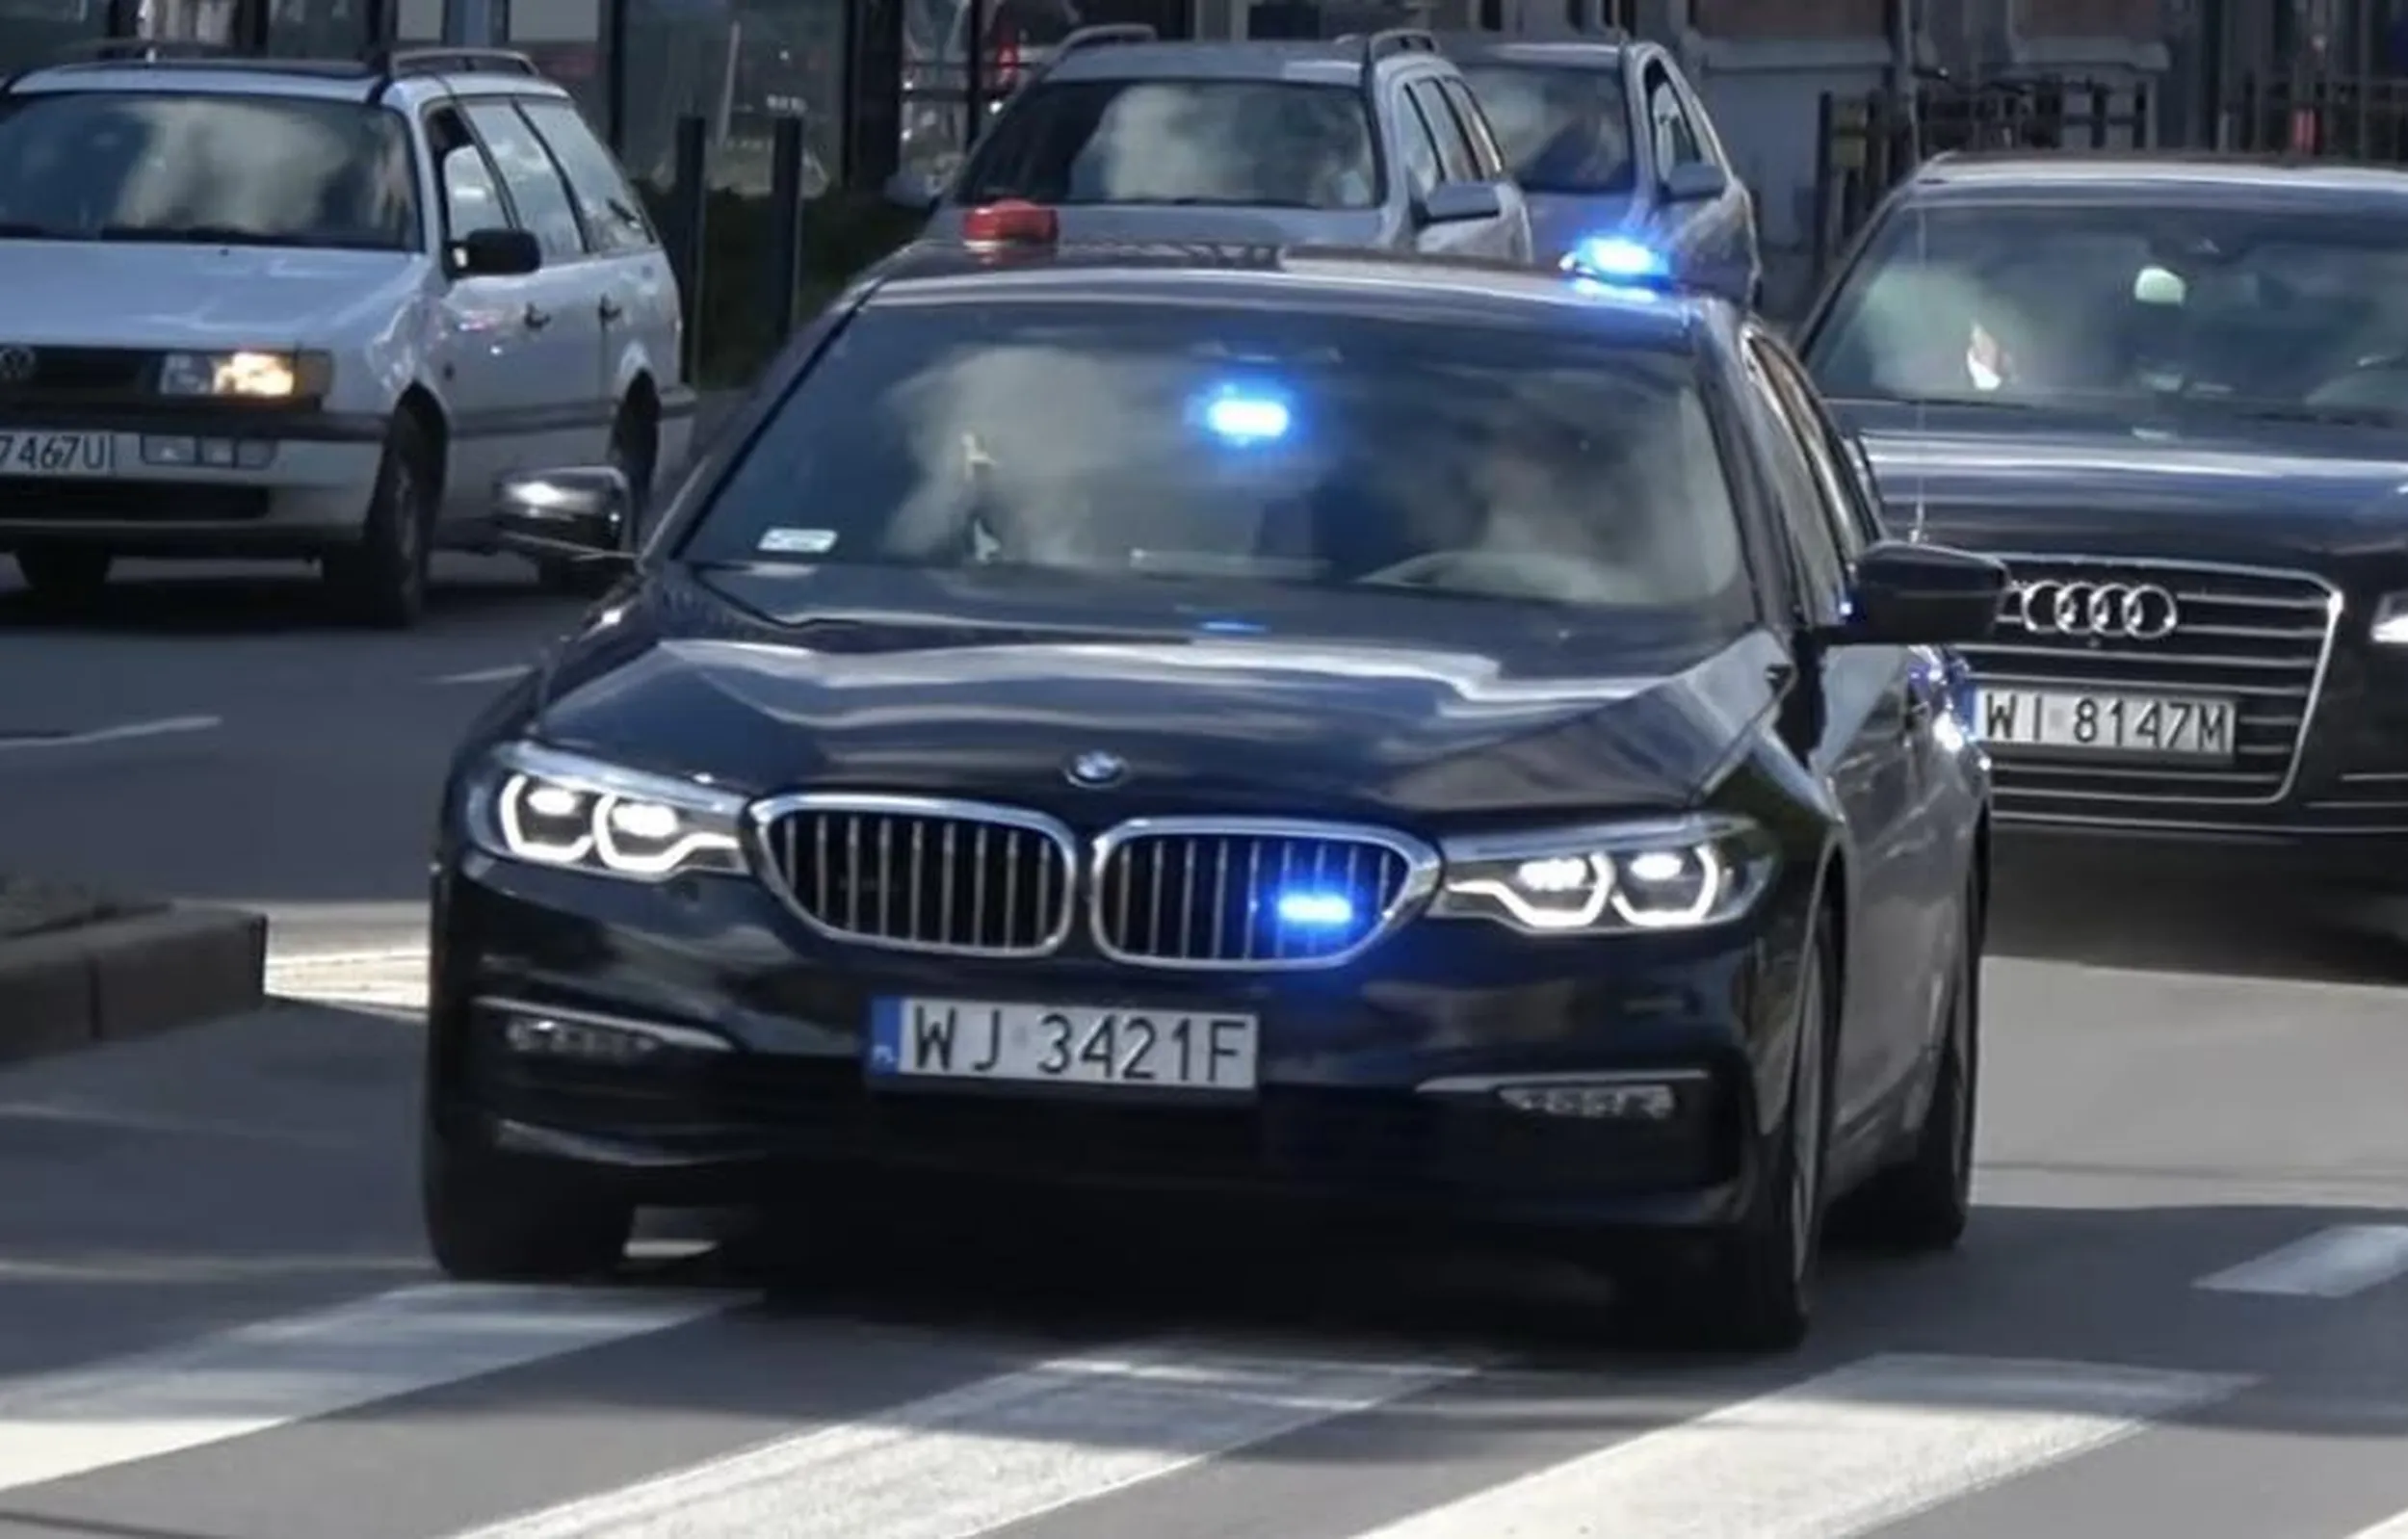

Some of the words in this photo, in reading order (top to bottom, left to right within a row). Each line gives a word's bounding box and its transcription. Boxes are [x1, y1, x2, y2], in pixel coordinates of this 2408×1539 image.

[1986, 692, 2041, 742] WI
[2074, 698, 2227, 753] 8147M
[915, 1005, 1002, 1072] WJ
[1037, 1012, 1246, 1083] 3421F
